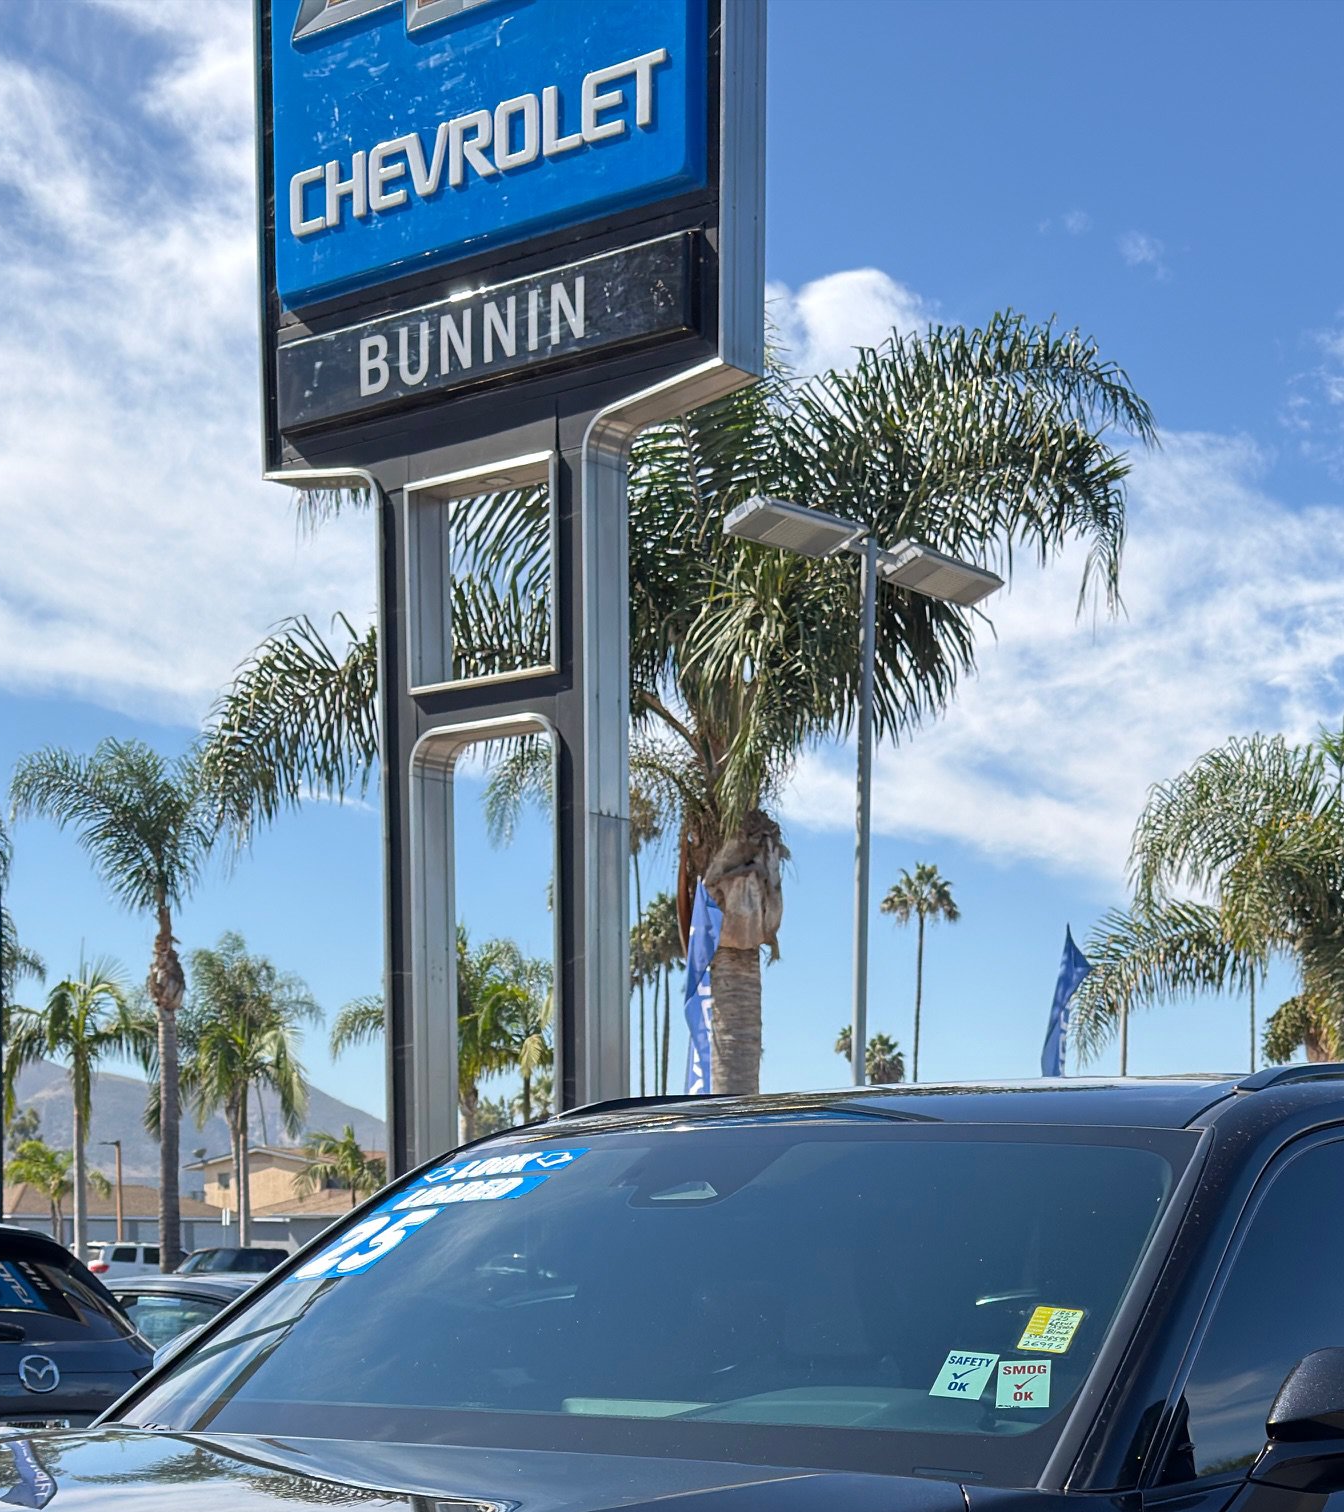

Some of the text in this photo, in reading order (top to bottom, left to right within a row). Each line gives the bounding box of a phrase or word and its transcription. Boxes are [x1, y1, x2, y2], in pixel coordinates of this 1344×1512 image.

[290, 47, 667, 238] CHEVROLET
[359, 275, 586, 398] BUNNIN
[450, 1151, 543, 1181] LOOK
[393, 1177, 524, 1211] LOADED
[294, 1208, 440, 1280] 25
[948, 1355, 994, 1367] SAFETY
[1002, 1364, 1047, 1375] SMOG
[947, 1381, 970, 1392] OK
[1013, 1391, 1034, 1402] OK
